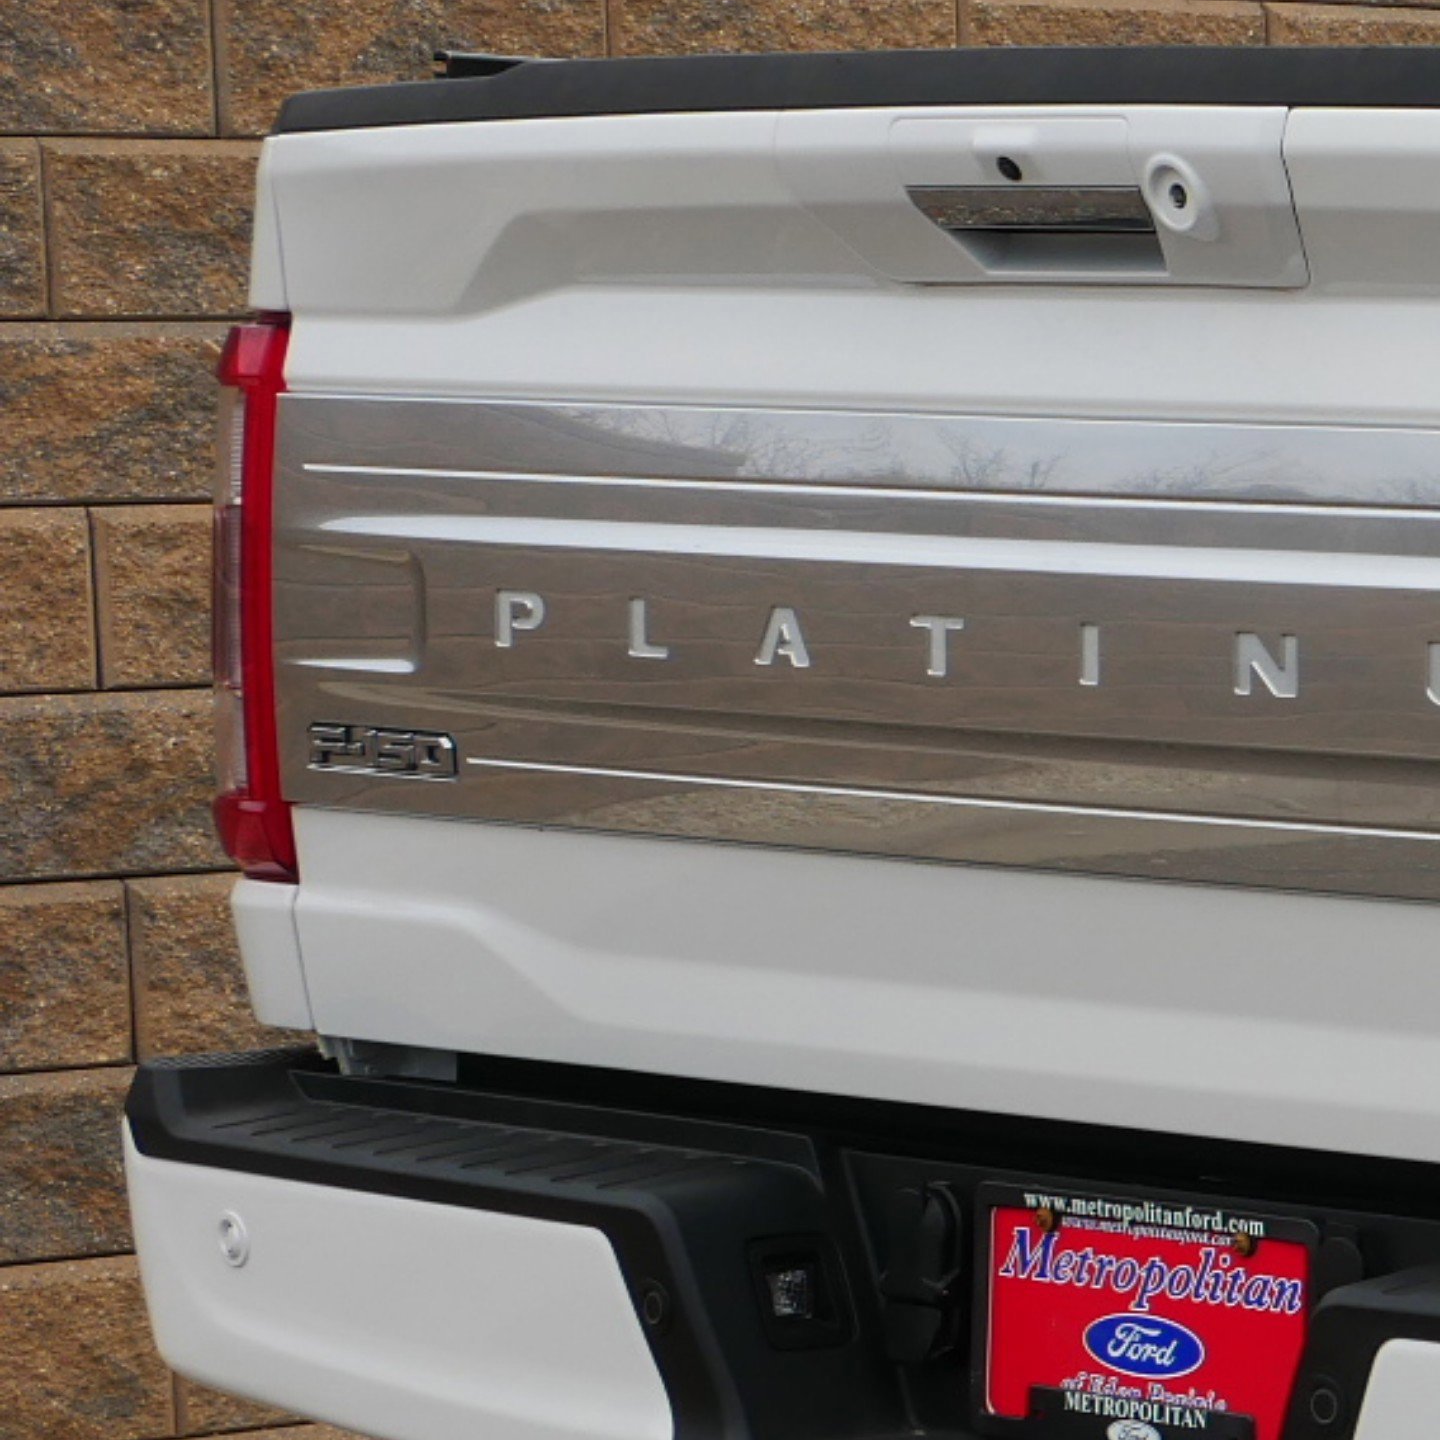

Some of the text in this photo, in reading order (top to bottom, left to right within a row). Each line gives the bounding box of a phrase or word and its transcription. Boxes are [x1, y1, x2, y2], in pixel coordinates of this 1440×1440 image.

[1023, 1192, 1265, 1237] www.metropolitanford.com
[999, 1226, 1303, 1314] Metropolitan
[1106, 1322, 1176, 1367] Ford
[1063, 1391, 1207, 1429] METROPOLITAN
